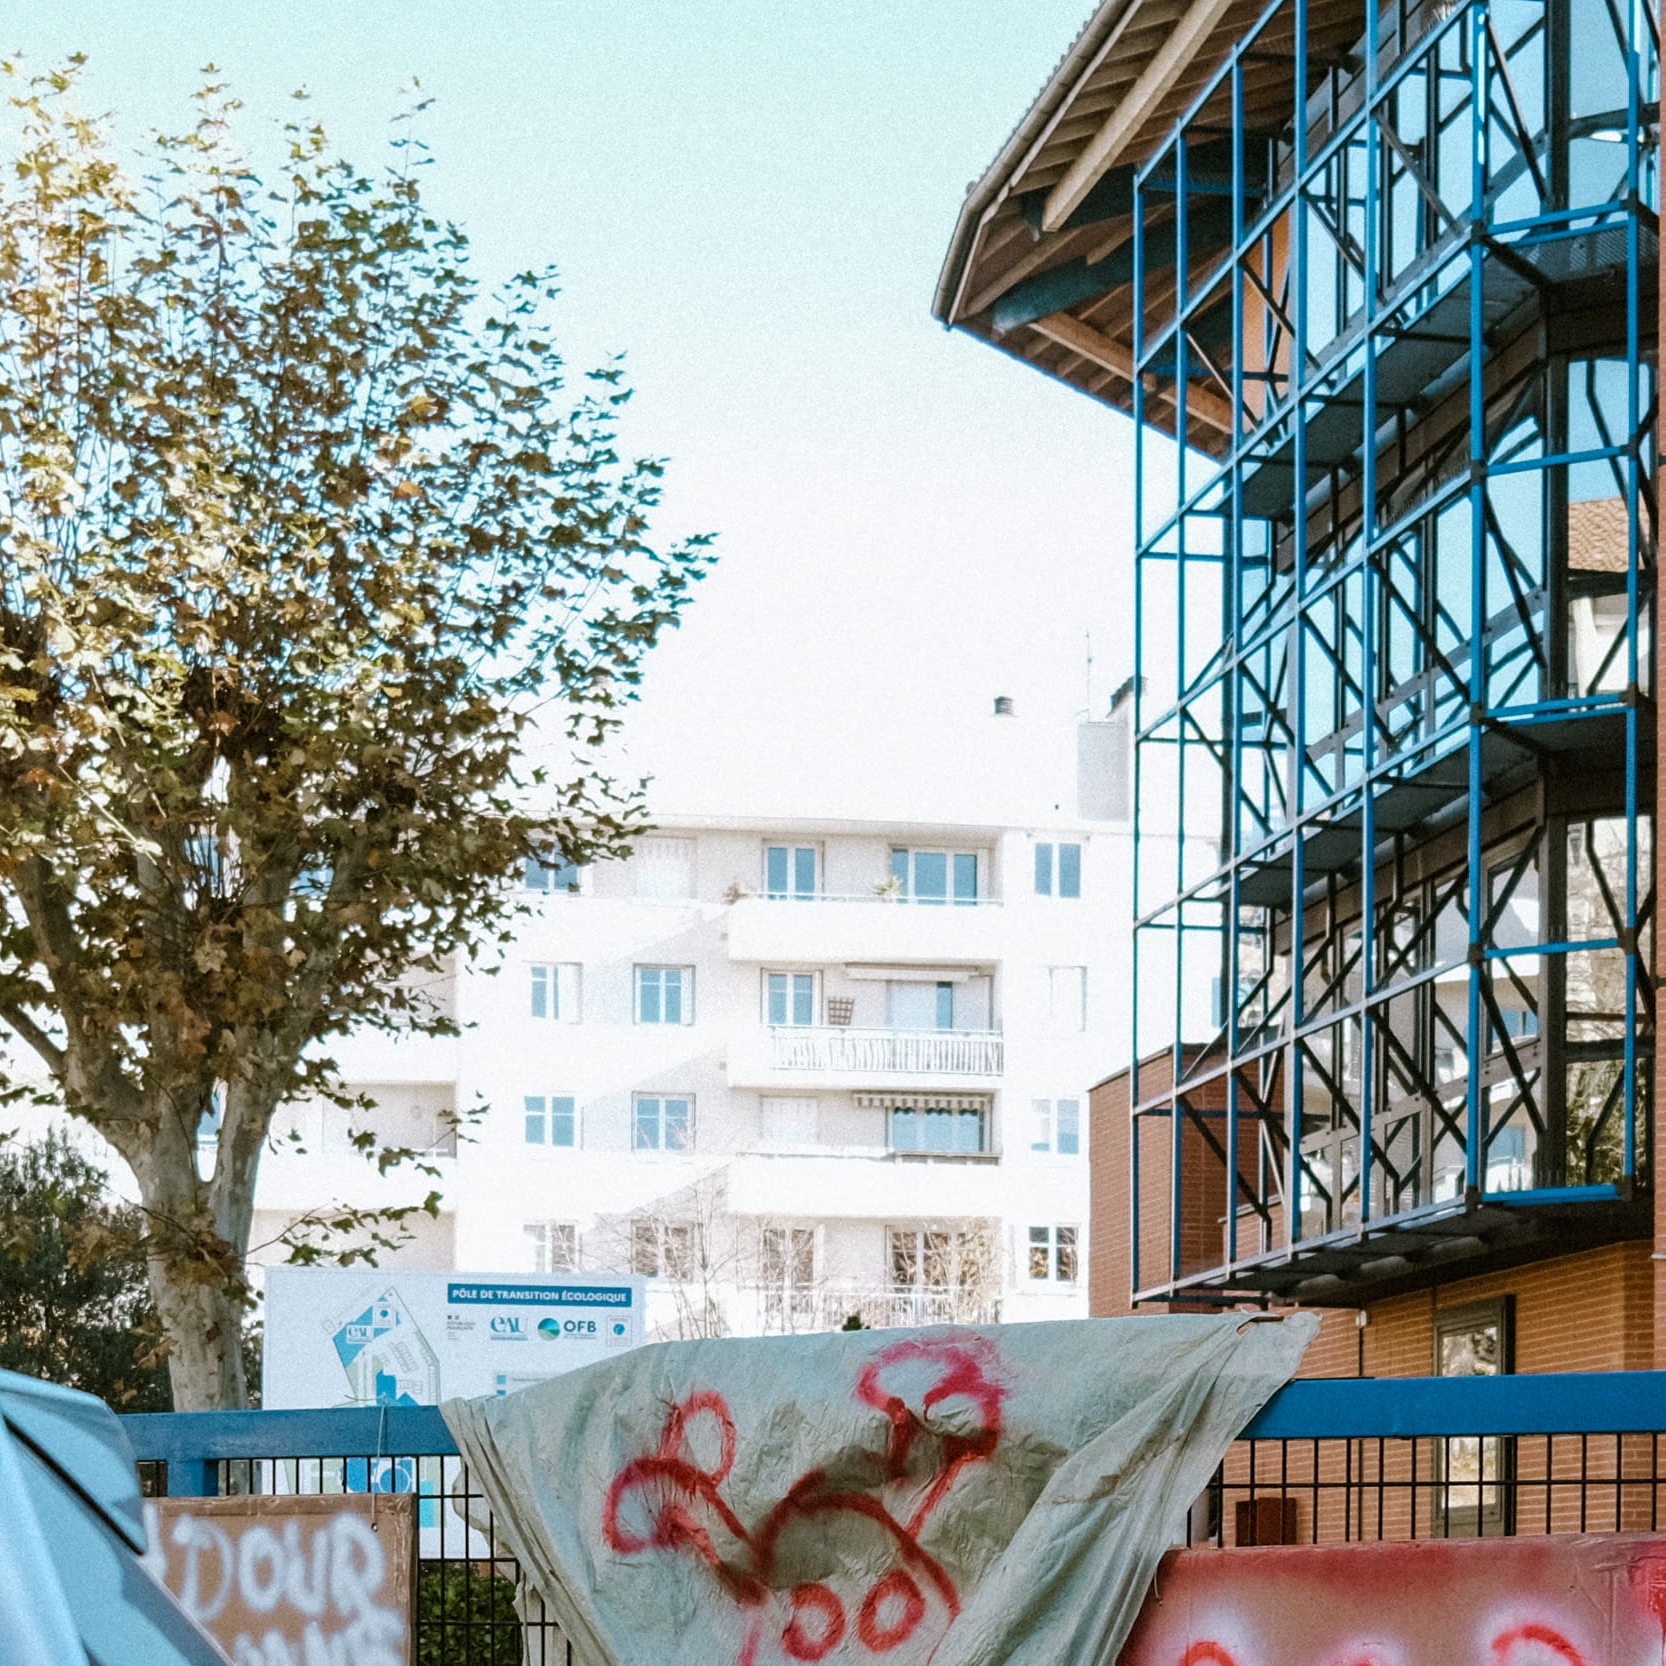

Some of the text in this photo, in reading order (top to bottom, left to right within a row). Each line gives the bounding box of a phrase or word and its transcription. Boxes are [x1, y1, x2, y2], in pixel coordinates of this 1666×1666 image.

[452, 1288, 627, 1303] PÔLE DE TRANSITION ÉCOLOGIQUE
[563, 1320, 597, 1333] OFB
